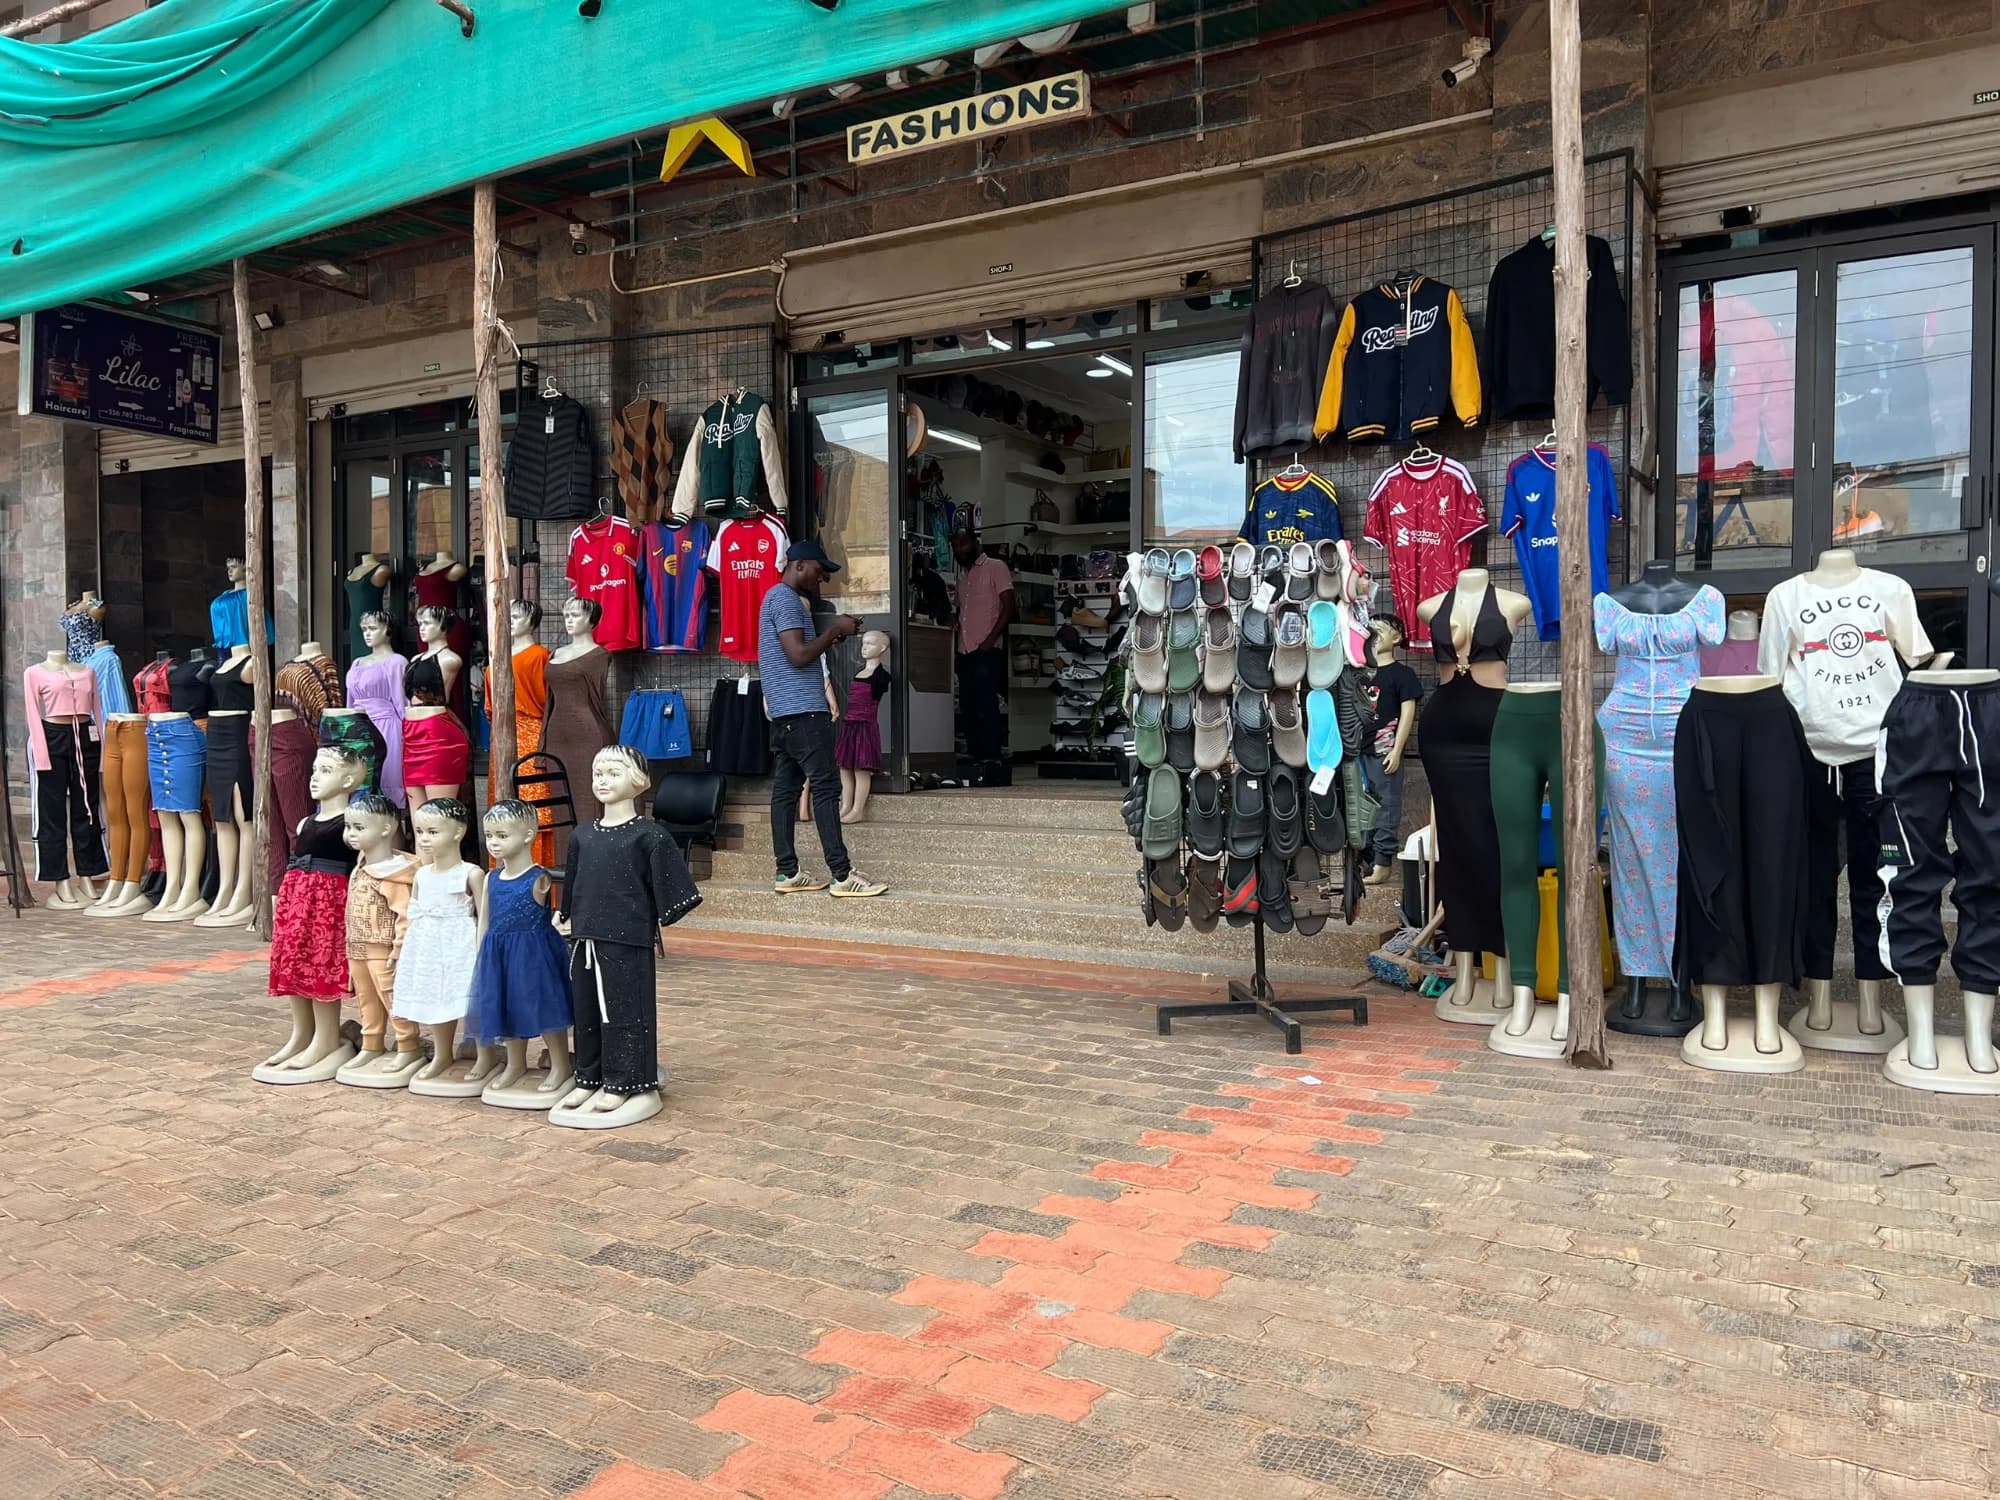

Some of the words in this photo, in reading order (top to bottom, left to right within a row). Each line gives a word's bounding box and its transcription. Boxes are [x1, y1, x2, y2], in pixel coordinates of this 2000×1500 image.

[851, 78, 1080, 157] FASHIONS
[98, 355, 161, 391] Lilac
[45, 400, 87, 416] Haircare
[1800, 595, 1881, 624] GUCCI
[1814, 657, 1887, 685] FIRENZE
[1838, 695, 1872, 709] 1921
